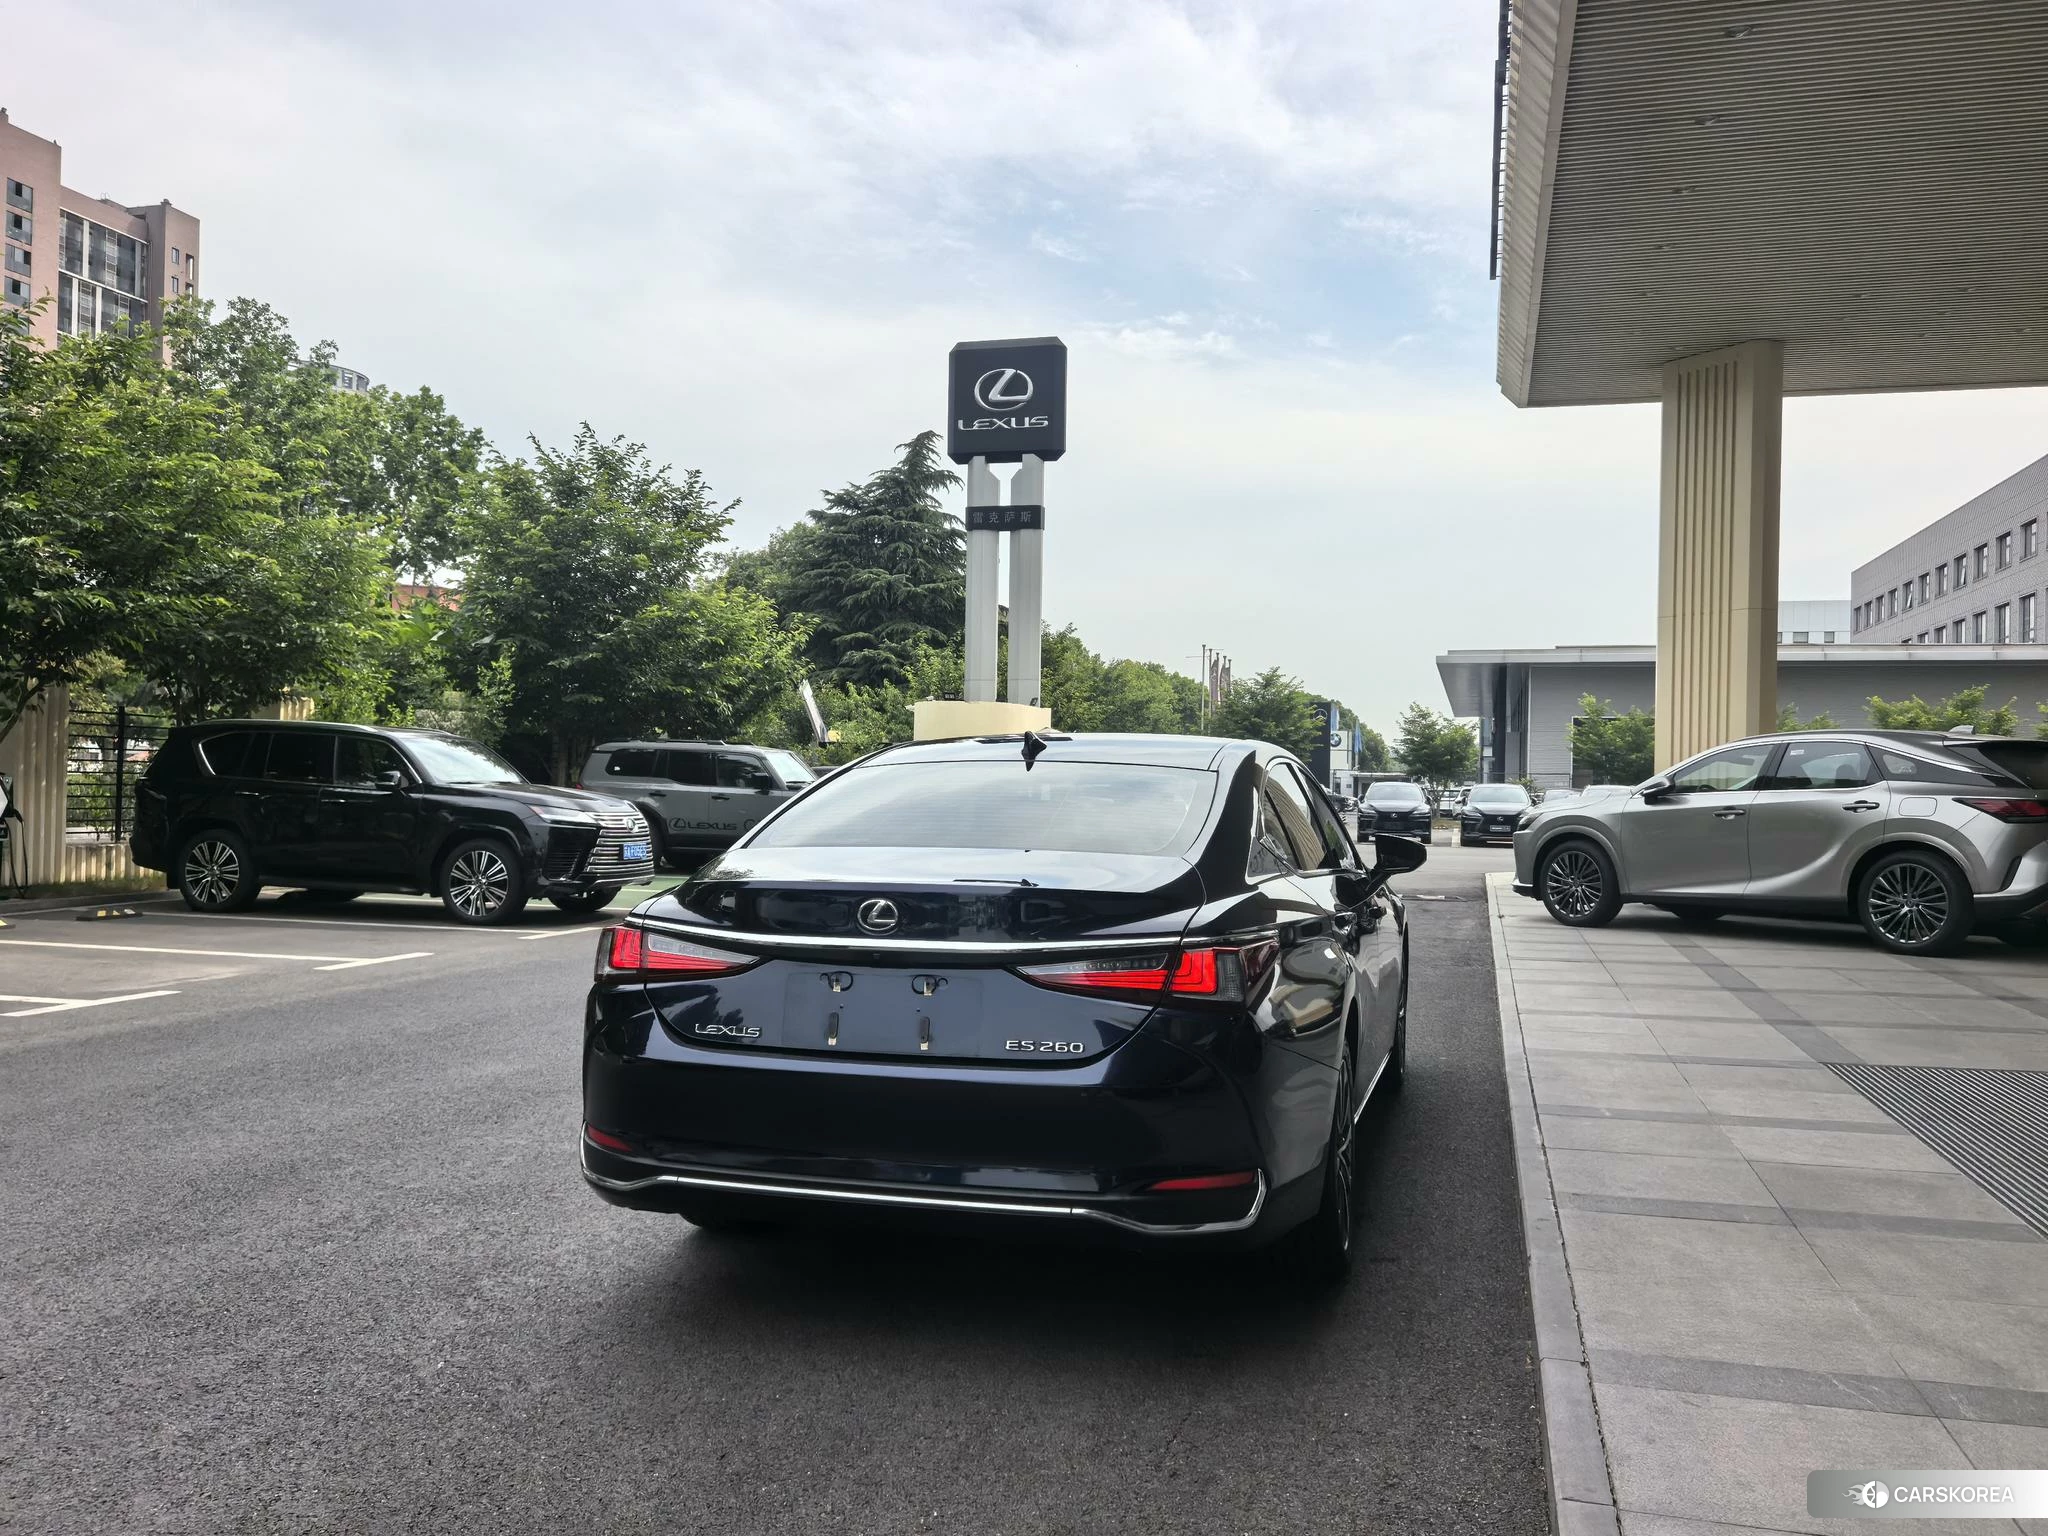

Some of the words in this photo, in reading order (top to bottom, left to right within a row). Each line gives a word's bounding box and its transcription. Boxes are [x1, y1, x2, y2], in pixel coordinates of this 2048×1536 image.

[957, 415, 1049, 431] LEXUS
[972, 511, 1032, 524] 雷克萨斯
[687, 821, 737, 830] LEXUS
[694, 1023, 761, 1038] LEXUS
[1005, 1040, 1035, 1053] ES
[1039, 1041, 1086, 1054] 260
